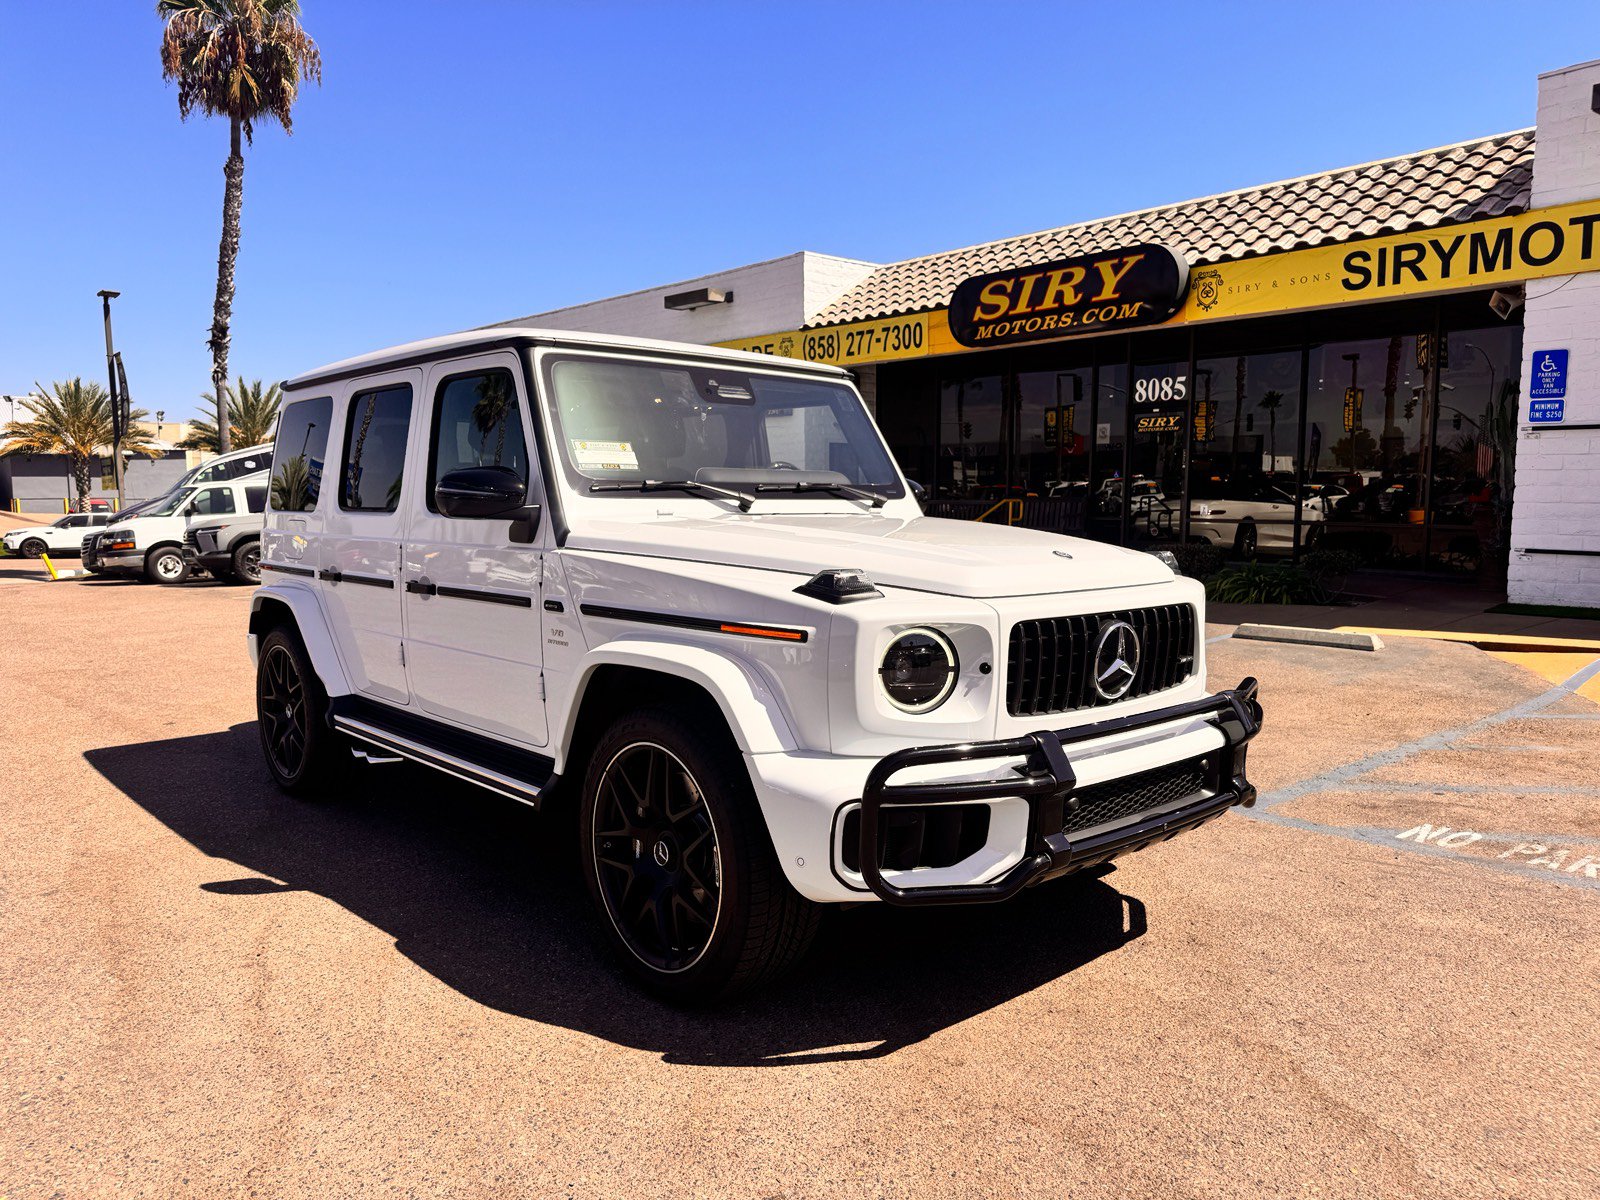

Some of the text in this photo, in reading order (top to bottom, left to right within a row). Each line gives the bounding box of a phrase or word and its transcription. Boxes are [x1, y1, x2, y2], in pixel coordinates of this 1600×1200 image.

[1341, 213, 1600, 291] SIRYMOT
[972, 253, 1146, 322] SIRY
[1227, 272, 1331, 295] SIRY & SONS
[974, 301, 1144, 341] MOTORS.COM
[803, 322, 923, 361] (858) 277-7300
[1134, 376, 1187, 403] 8085
[1138, 416, 1180, 428] SIRY
[1530, 410, 1562, 419] FINE $250
[1395, 823, 1483, 848] NO
